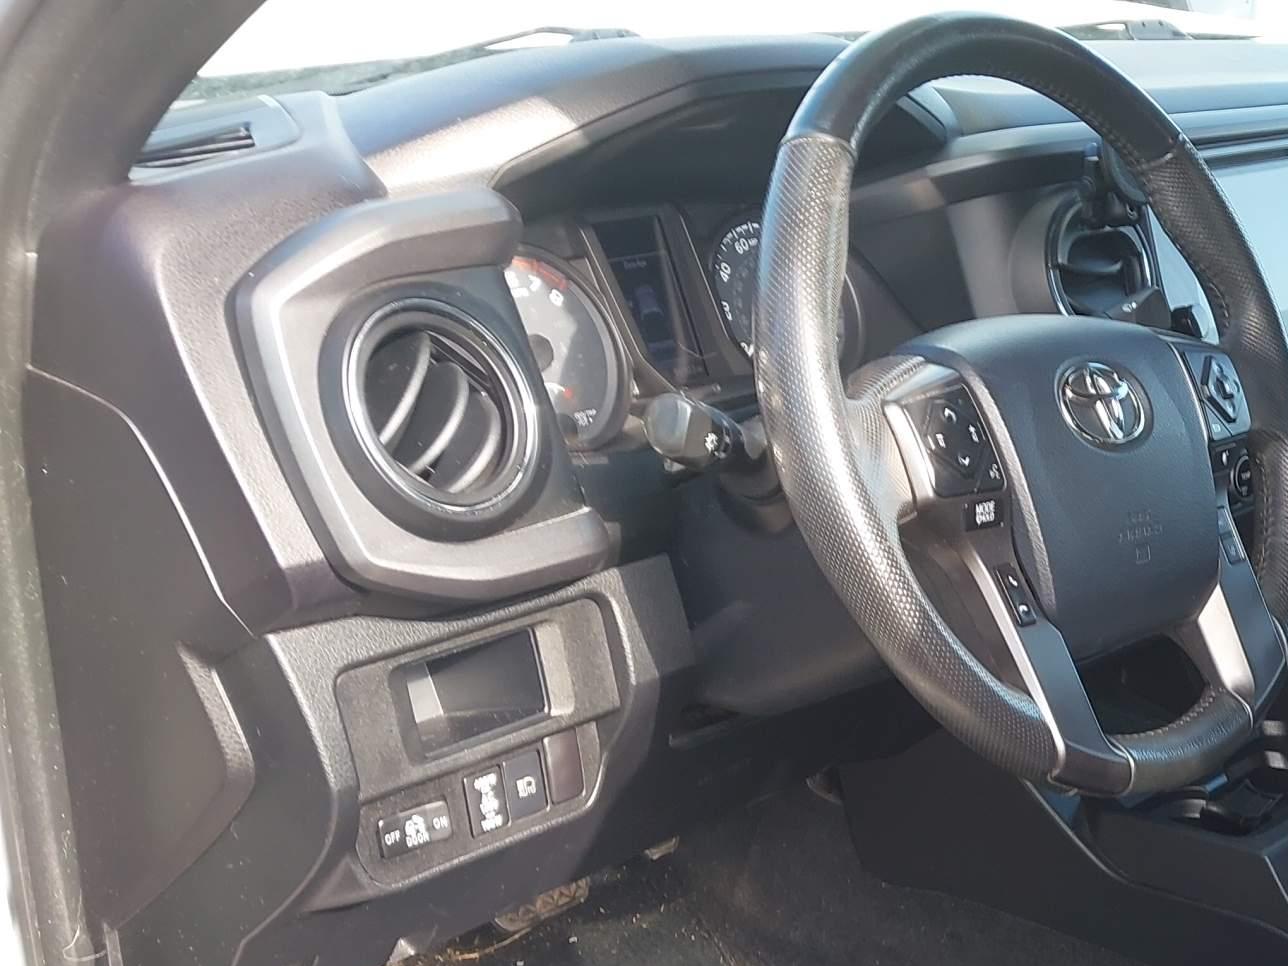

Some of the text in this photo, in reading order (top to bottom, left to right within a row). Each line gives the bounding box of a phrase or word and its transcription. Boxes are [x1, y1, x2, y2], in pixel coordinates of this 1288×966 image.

[734, 237, 749, 255] 60
[720, 262, 731, 282] 40
[433, 816, 448, 829] ON
